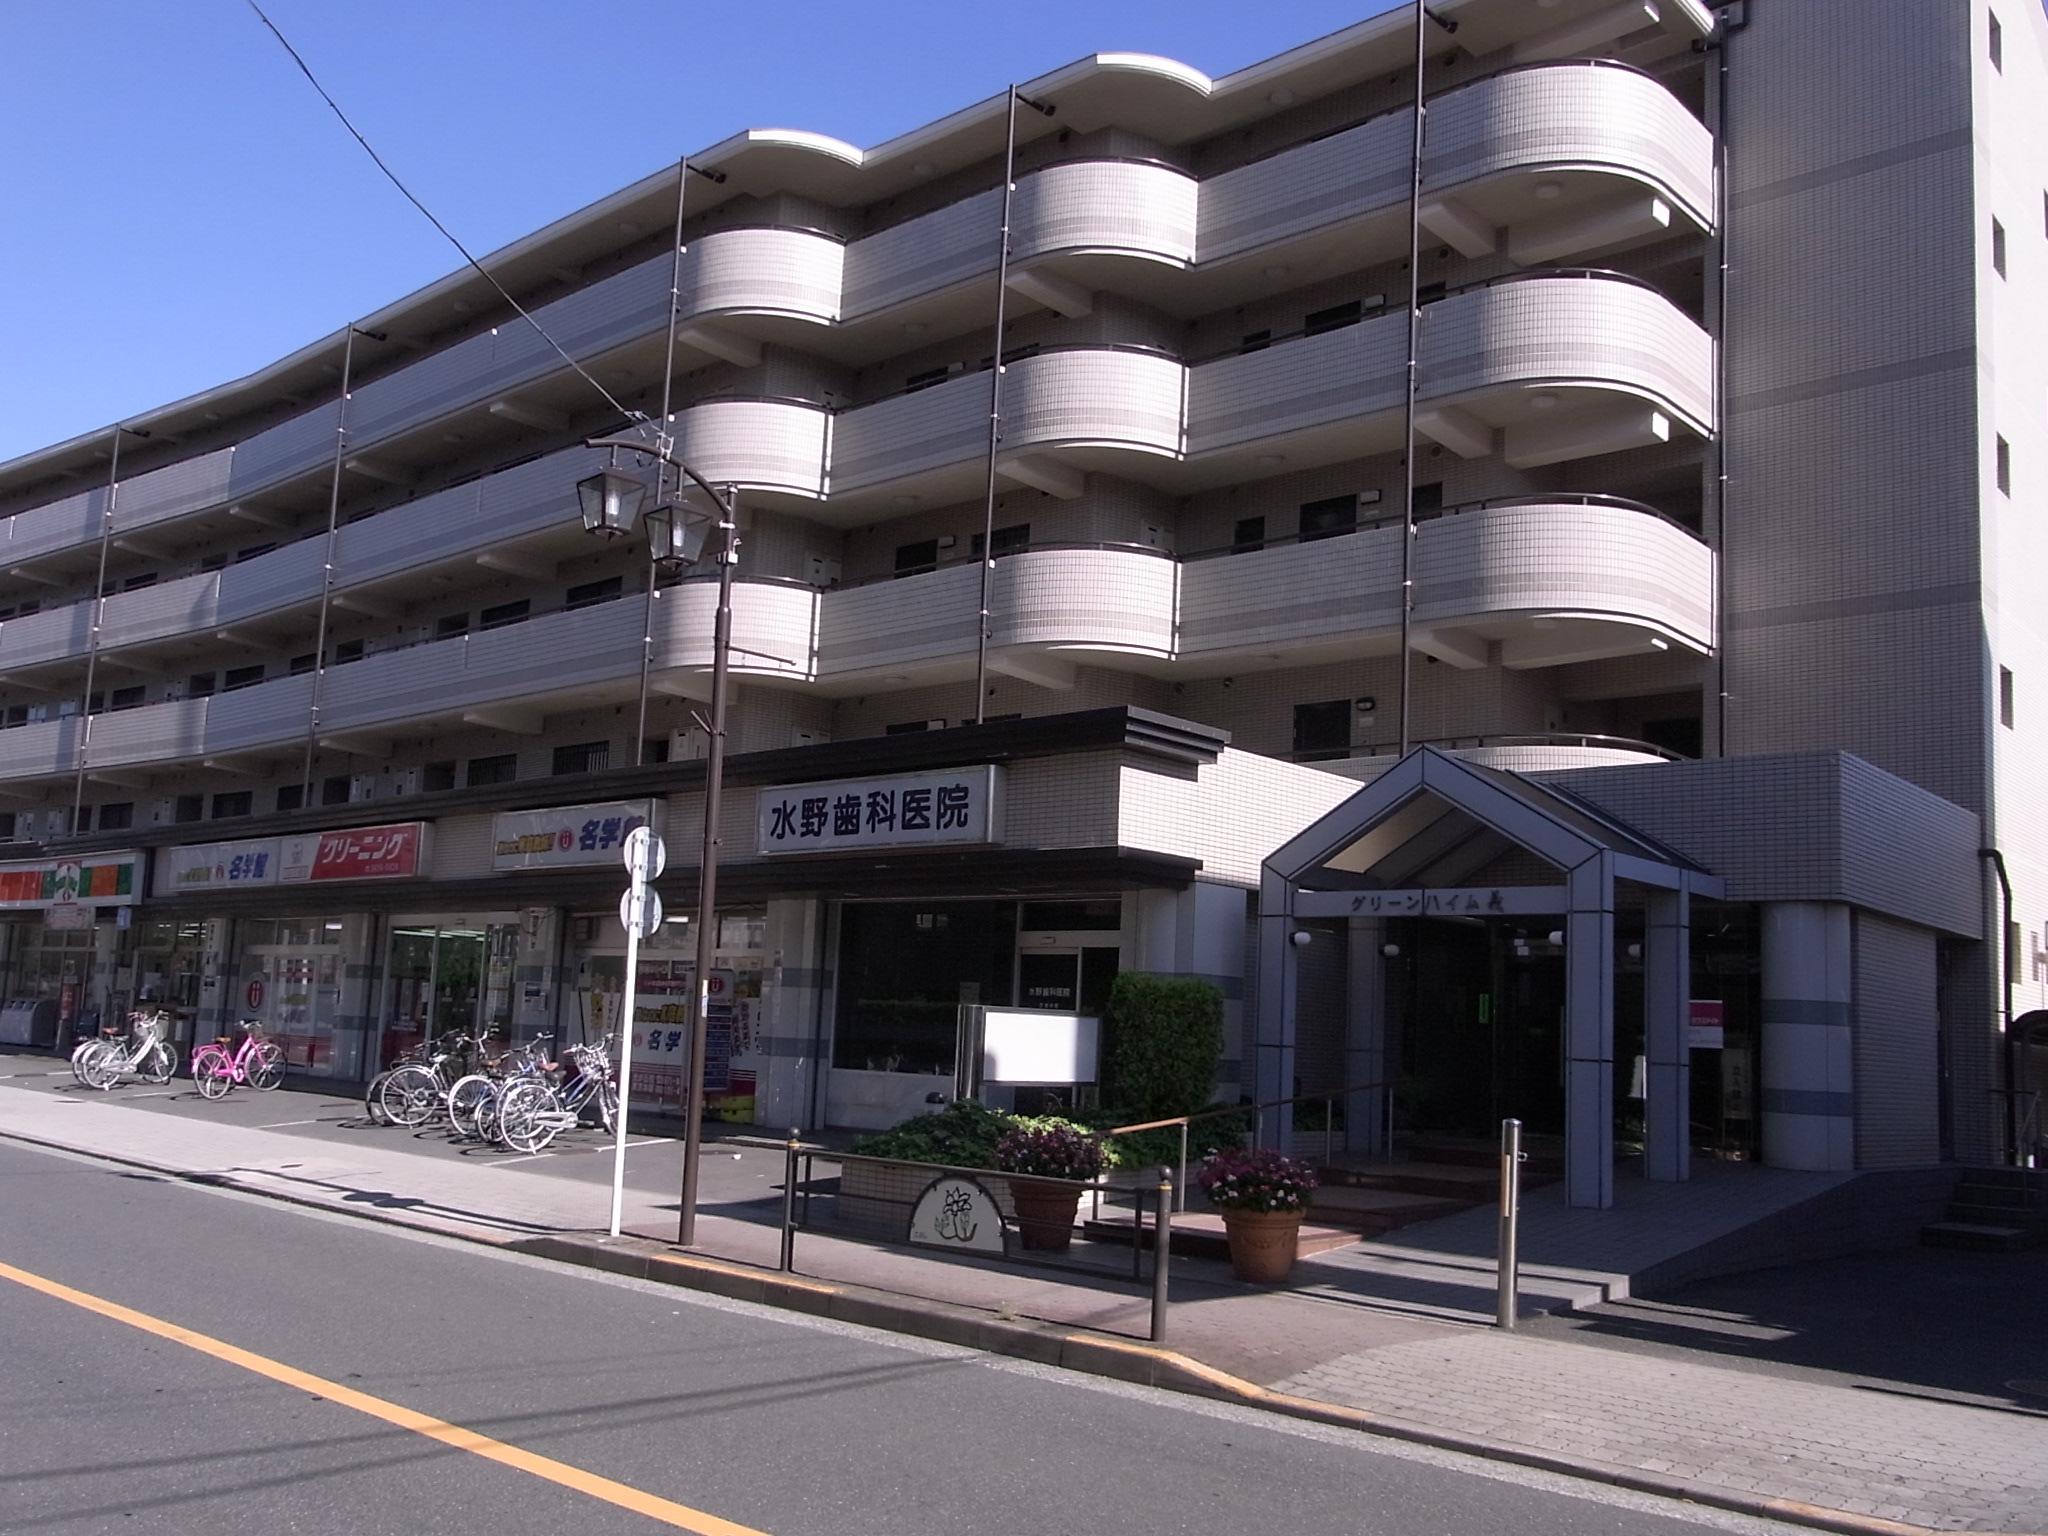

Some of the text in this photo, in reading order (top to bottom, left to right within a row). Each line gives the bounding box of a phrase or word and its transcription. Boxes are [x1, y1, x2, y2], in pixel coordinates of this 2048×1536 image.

[770, 784, 969, 839] 水野歯科医院
[322, 833, 408, 863] クリーニング
